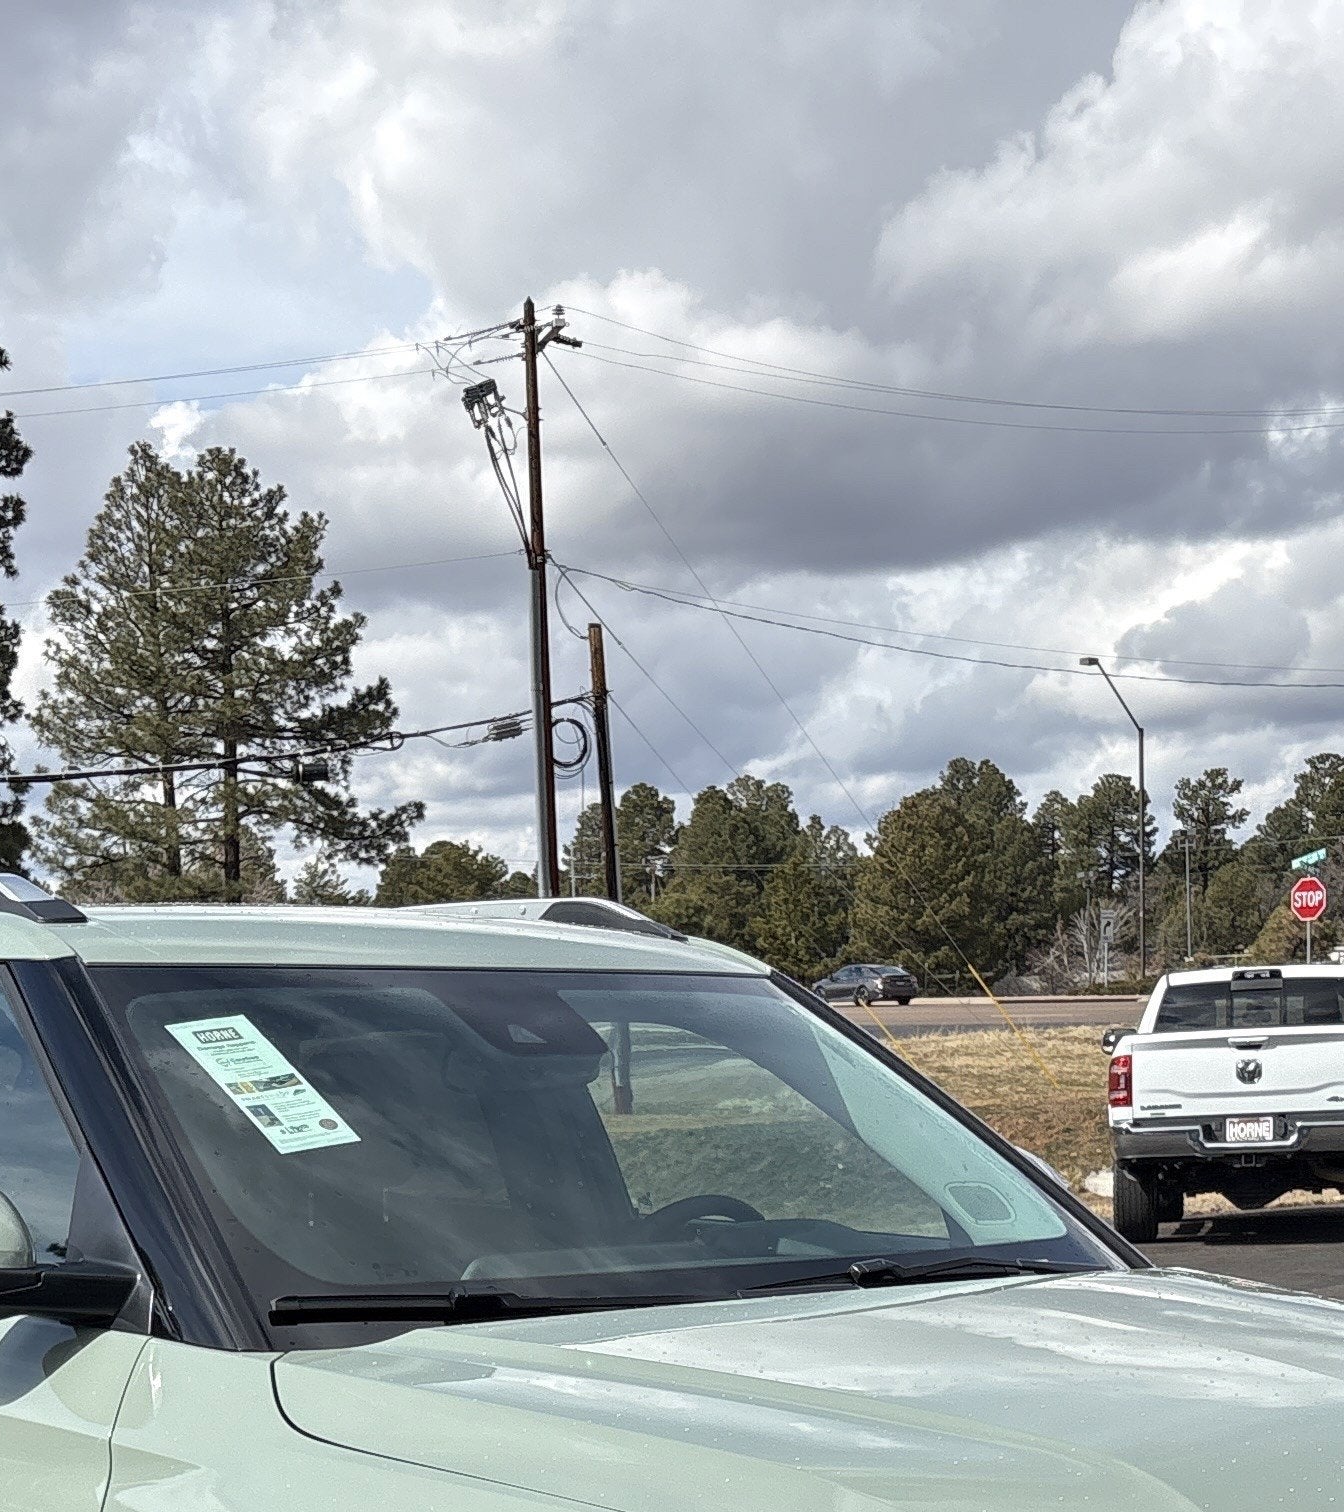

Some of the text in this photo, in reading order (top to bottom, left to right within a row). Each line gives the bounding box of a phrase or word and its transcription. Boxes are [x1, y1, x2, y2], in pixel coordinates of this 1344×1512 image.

[1293, 890, 1323, 908] STOP
[196, 1028, 240, 1042] HORNE
[1229, 1121, 1271, 1140] HORNE
